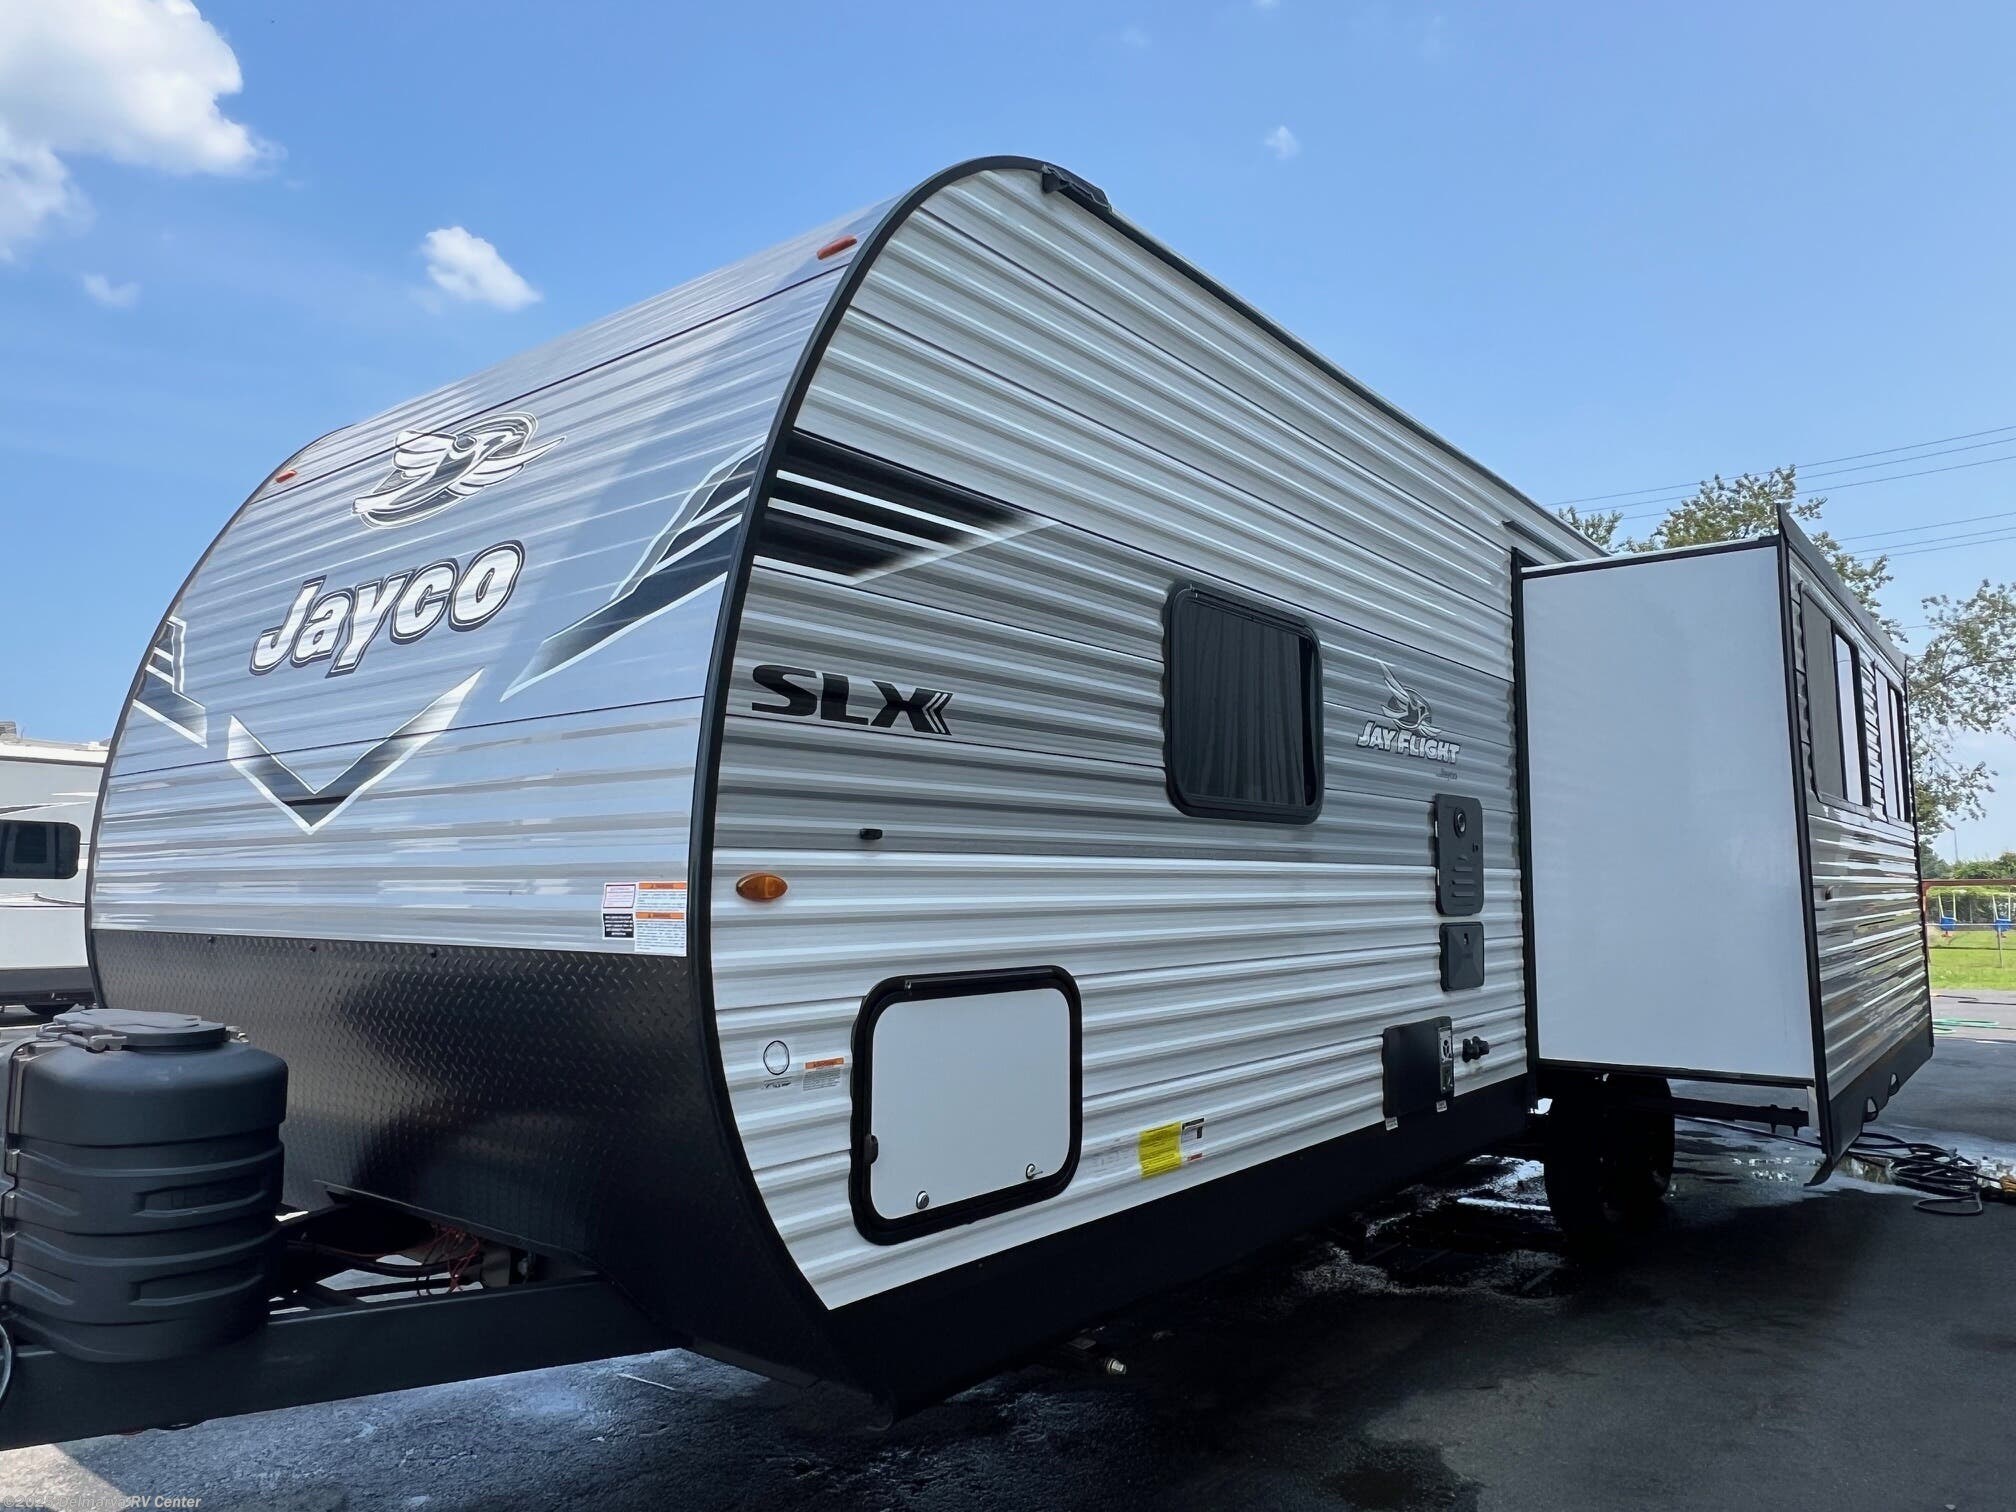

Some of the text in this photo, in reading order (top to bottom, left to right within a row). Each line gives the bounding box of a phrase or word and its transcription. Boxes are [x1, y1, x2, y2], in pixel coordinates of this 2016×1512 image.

[249, 539, 526, 679] Jayco
[752, 664, 953, 735] SLX
[1356, 720, 1461, 764] JAY FLIGHT
